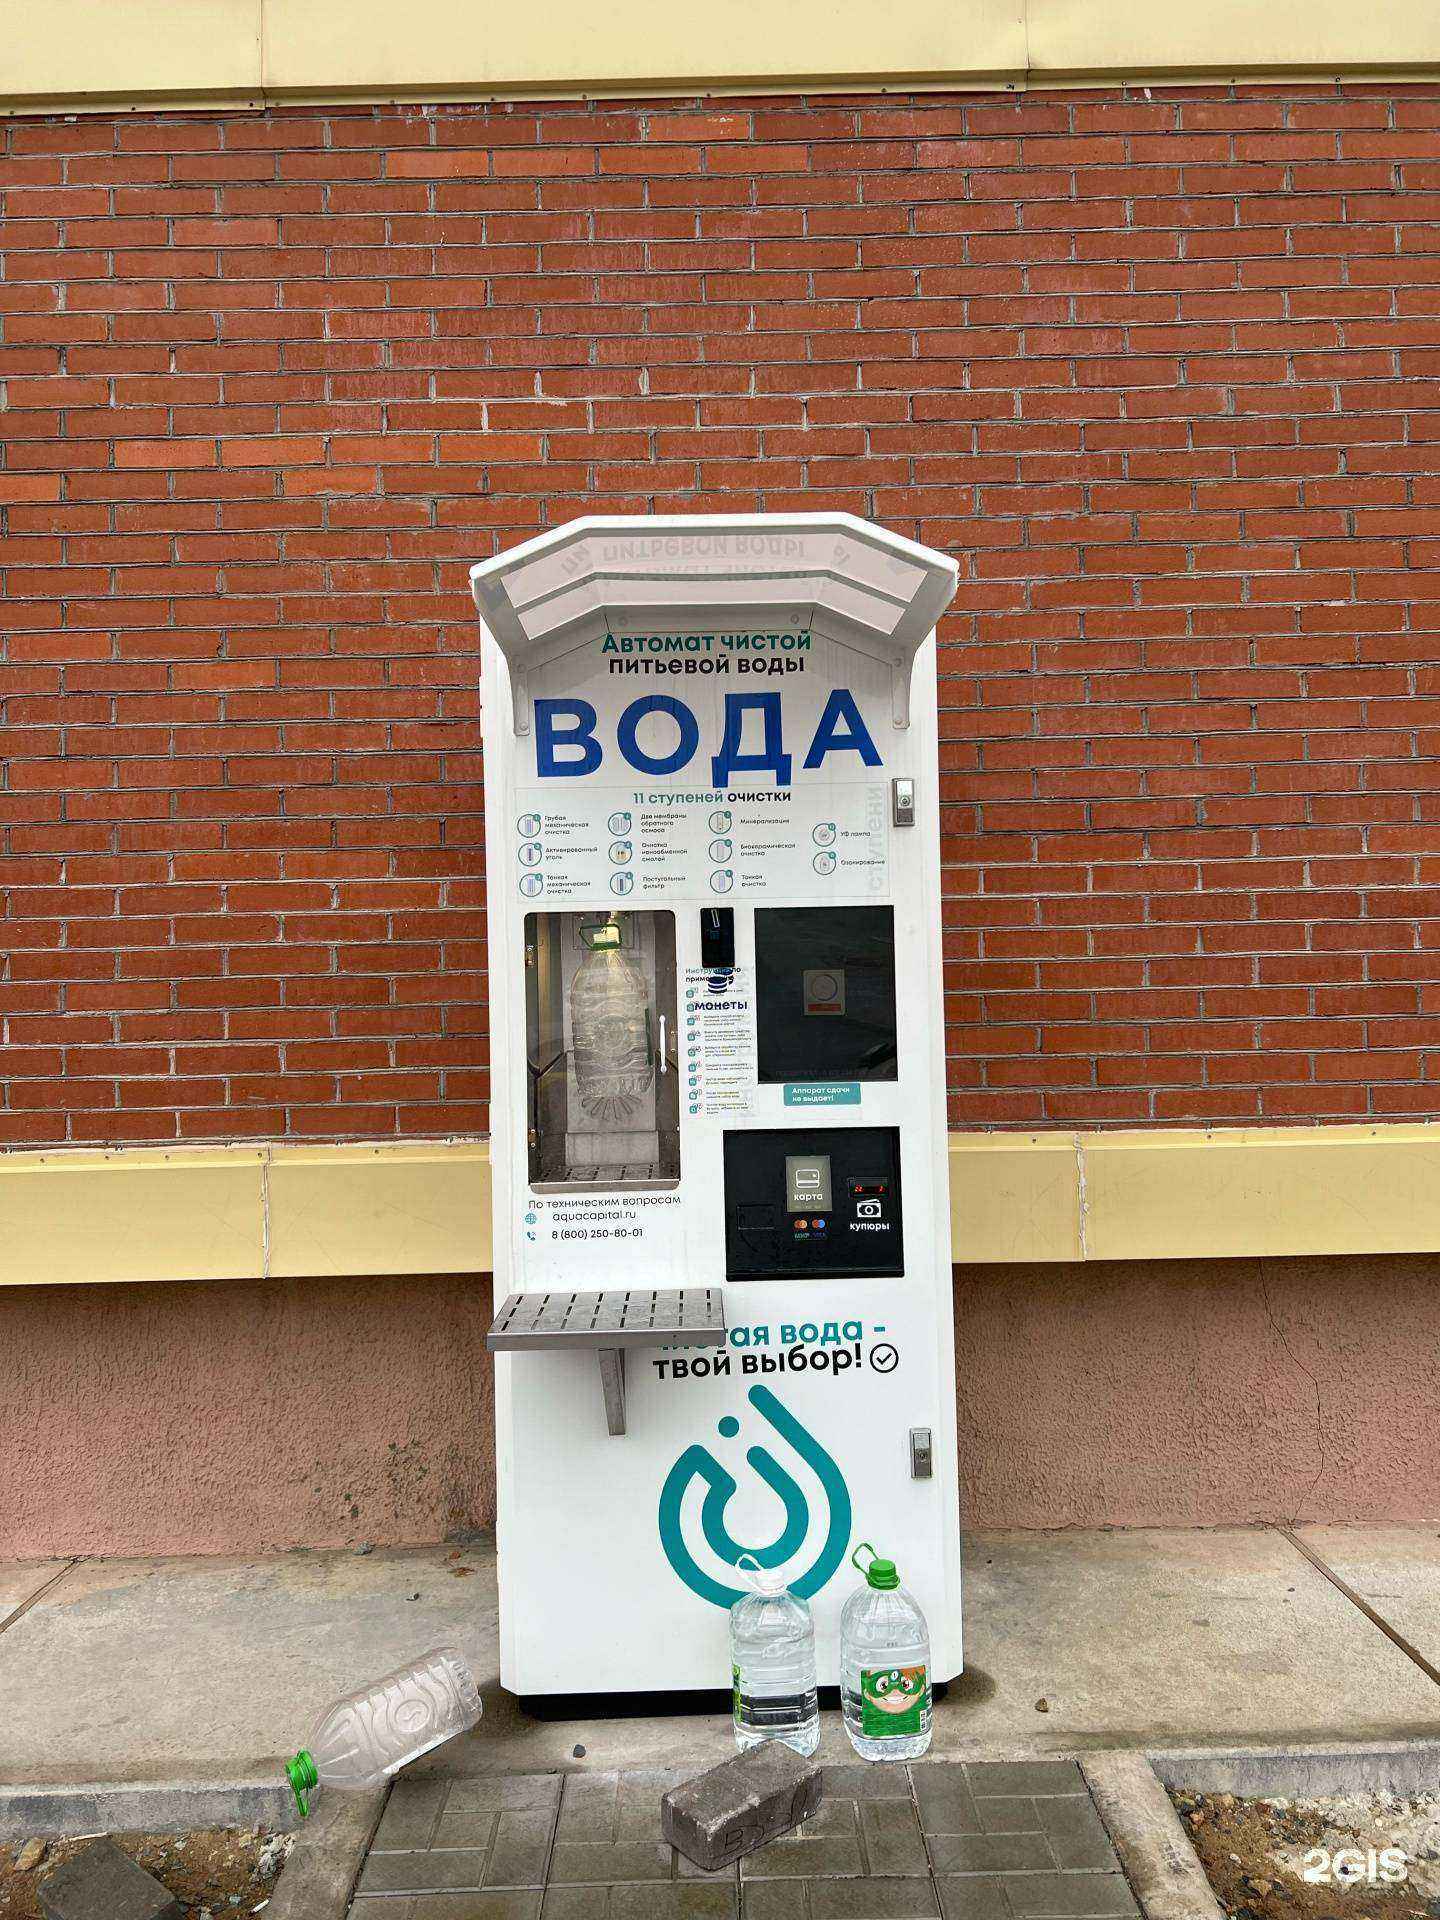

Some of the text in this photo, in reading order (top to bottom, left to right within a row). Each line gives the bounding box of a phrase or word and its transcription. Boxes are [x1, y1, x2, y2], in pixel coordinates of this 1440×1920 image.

[602, 630, 811, 653] Автомат чистой
[609, 654, 804, 675] питьевой воды
[534, 689, 884, 788] ВОДА
[634, 791, 791, 806] 11 ступеней очистки
[694, 1001, 748, 1010] монеты
[791, 1087, 850, 1095] Аппарат сдачи
[528, 1196, 681, 1209] По техническим вопросам
[794, 1193, 823, 1202] карта
[552, 1210, 636, 1223] aquacapital.ru
[552, 1228, 643, 1240] 8 (800) 250-80-01
[849, 1223, 890, 1232] купюры
[780, 1320, 863, 1346] вода
[652, 1343, 862, 1379] твой выбор!
